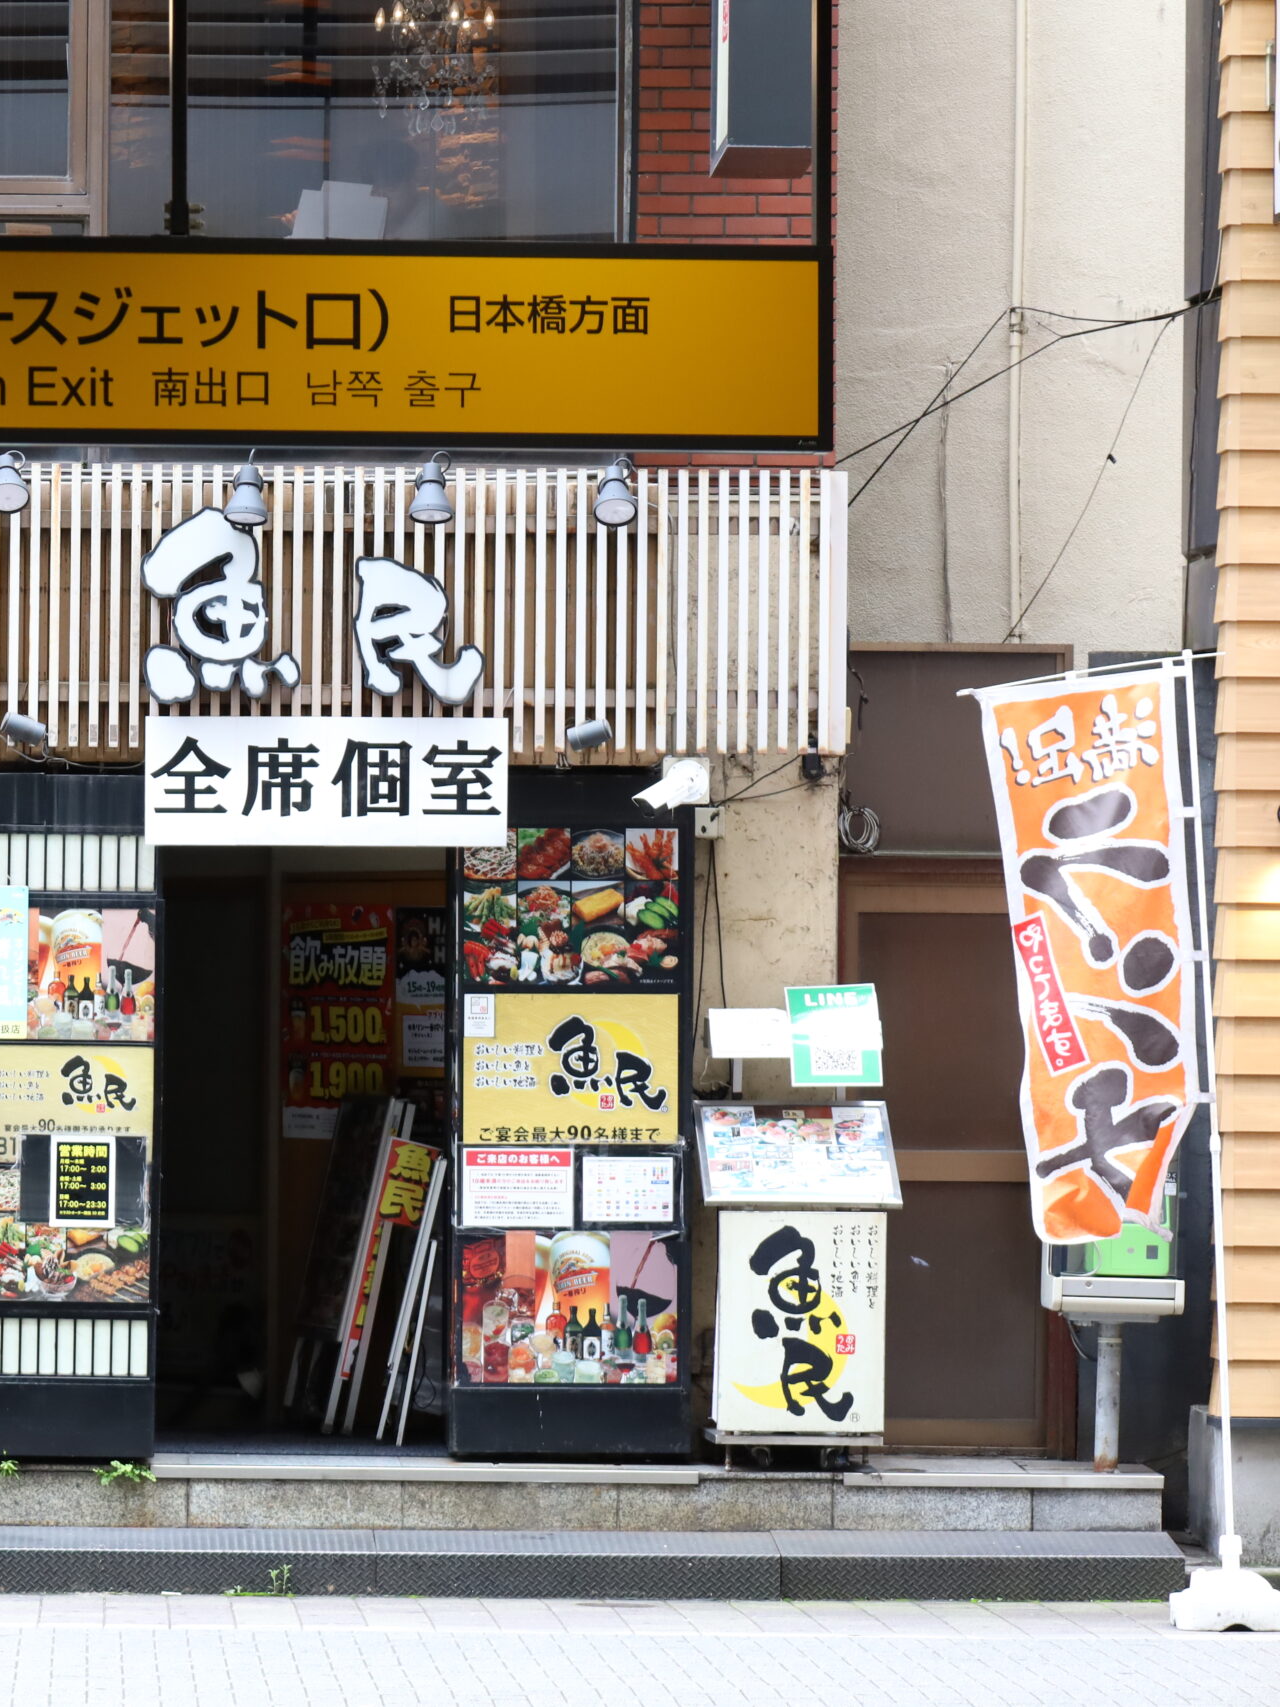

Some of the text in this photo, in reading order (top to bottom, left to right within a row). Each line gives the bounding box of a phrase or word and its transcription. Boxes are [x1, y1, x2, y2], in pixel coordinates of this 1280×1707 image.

[448, 295, 650, 335] 日本橋方面
[27, 366, 114, 407] Exit
[152, 367, 269, 407] 南出口
[307, 370, 481, 408] 남쪽 출구
[140, 506, 486, 706] 魚民
[150, 736, 503, 818] 全席個室
[289, 936, 387, 986] 飲み放題
[804, 991, 858, 1007] LINE
[548, 1015, 668, 1110] 魚民
[61, 1055, 137, 1111] 魚民
[59, 1145, 108, 1158] 営業時間
[479, 1125, 661, 1143] ご宴会最大90名様まで
[91, 1165, 107, 1173] 2:00
[476, 1153, 561, 1165] ご来店のお客様へ
[379, 1143, 432, 1224] 魚民
[749, 1225, 854, 1422] 魚民
